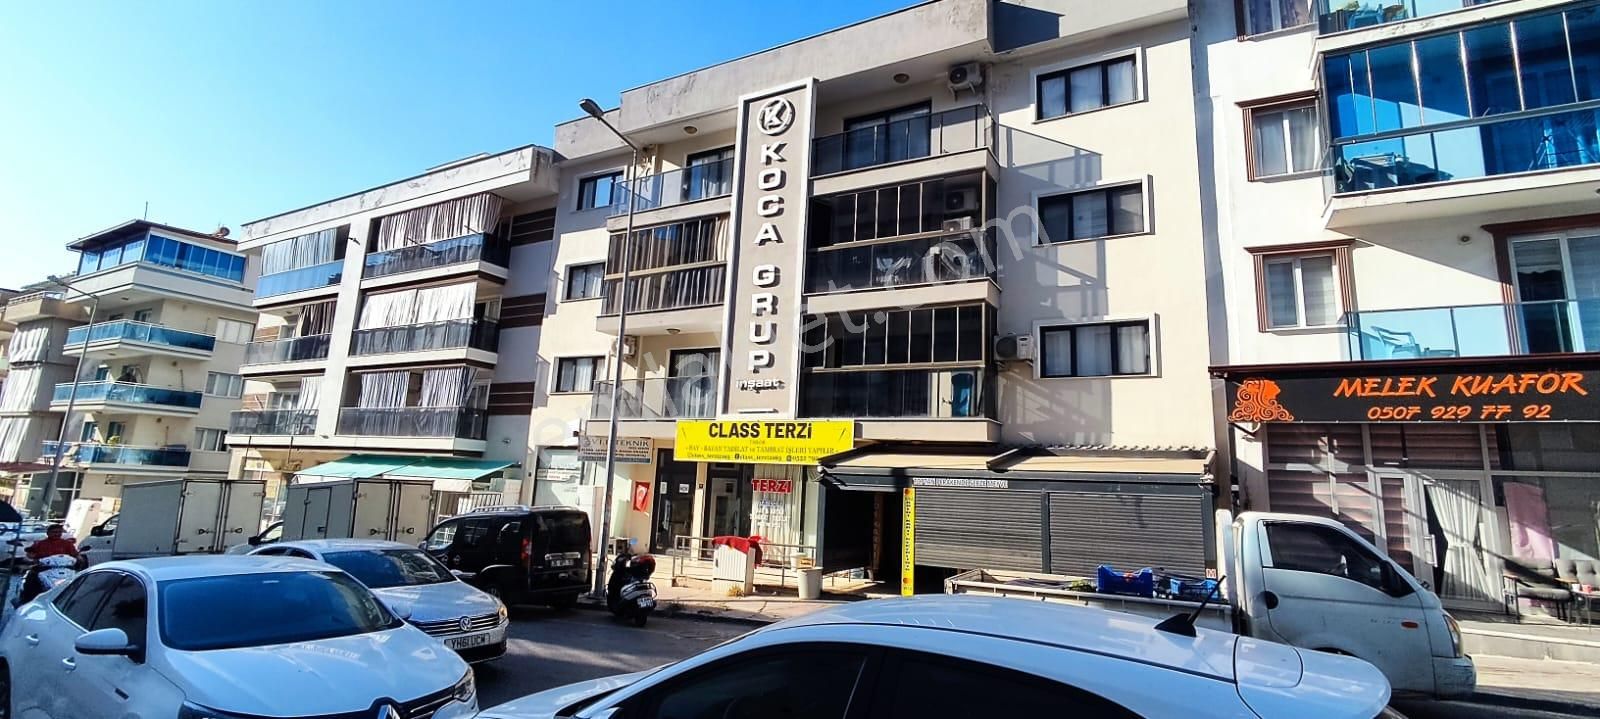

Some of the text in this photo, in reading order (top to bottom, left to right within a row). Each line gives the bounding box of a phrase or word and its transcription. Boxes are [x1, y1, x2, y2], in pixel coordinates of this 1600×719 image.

[748, 142, 785, 371] KOCA GRUP
[1333, 377, 1438, 397] MELEK
[1367, 404, 1551, 420] 0507 929 77 92
[709, 422, 760, 438] CLASS
